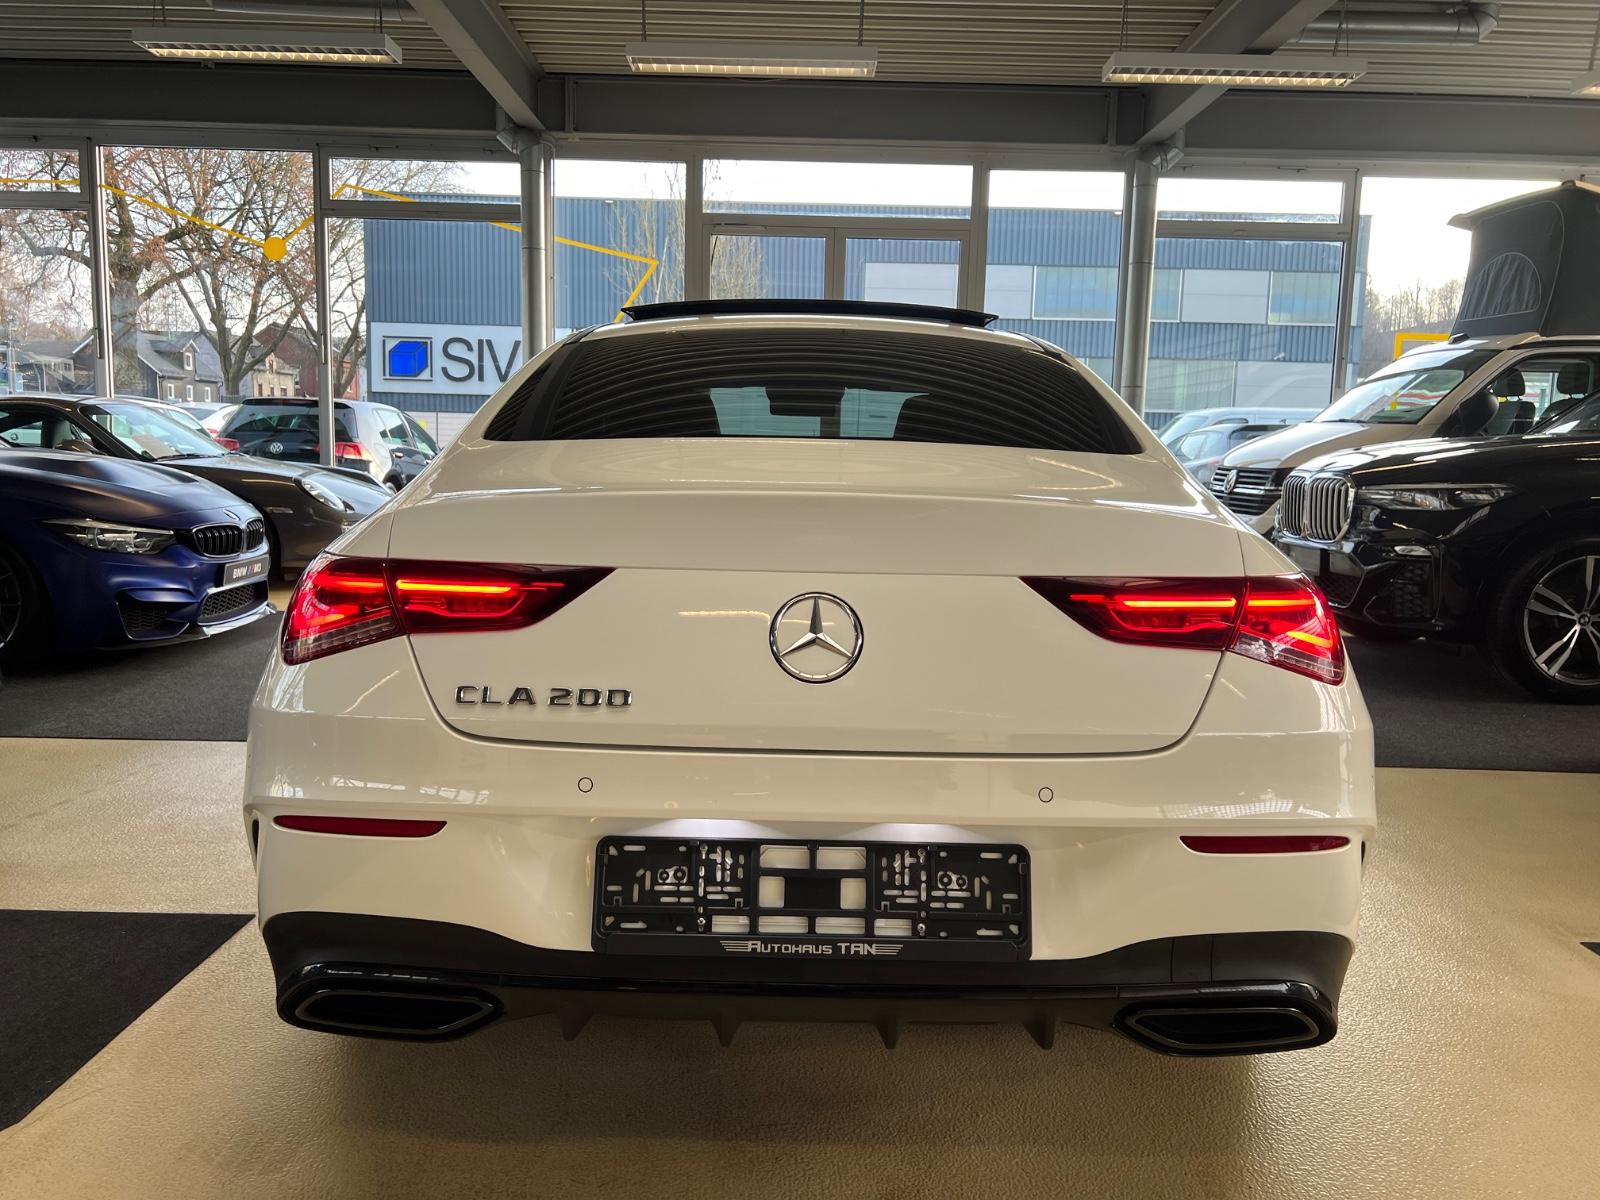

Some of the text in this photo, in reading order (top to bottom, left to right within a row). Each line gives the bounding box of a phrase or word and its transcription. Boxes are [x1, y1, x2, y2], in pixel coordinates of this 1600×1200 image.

[441, 337, 522, 382] SIV
[233, 566, 248, 579] BMW
[455, 686, 632, 707] CLA 200
[837, 942, 876, 955] TAN
